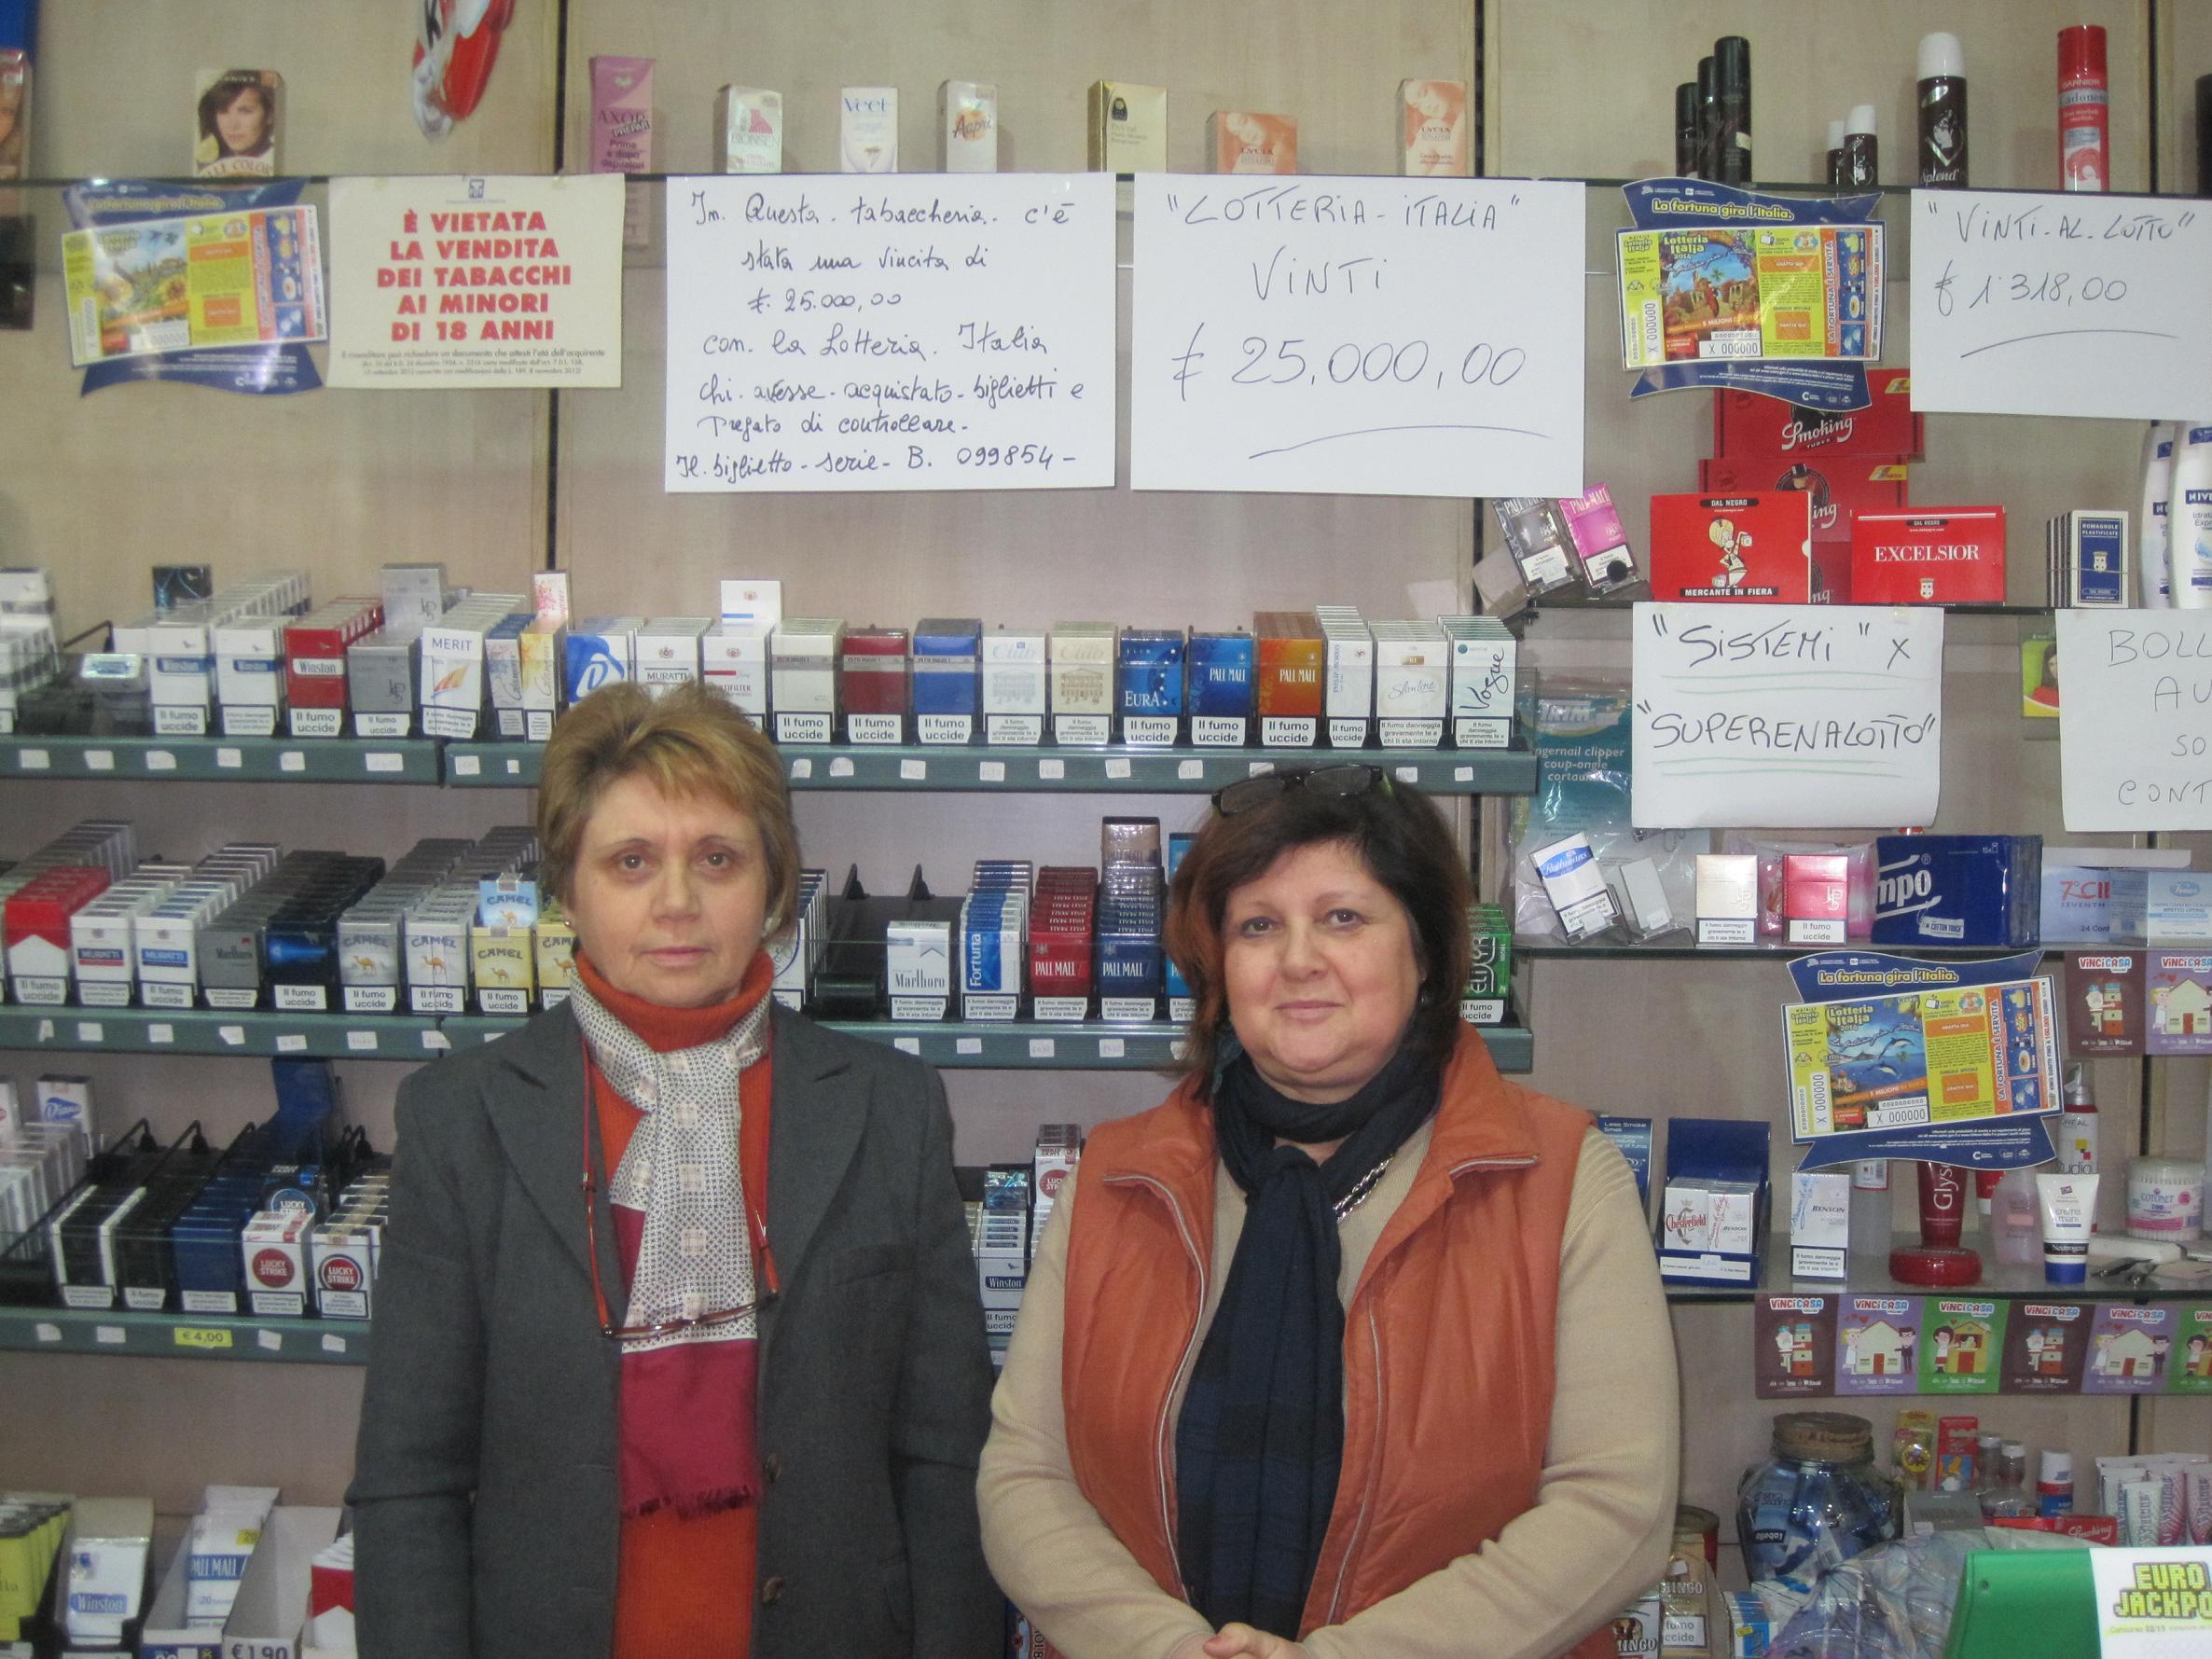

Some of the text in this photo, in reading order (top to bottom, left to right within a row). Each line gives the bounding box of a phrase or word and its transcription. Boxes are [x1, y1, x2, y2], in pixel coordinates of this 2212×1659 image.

[1653, 200, 1667, 213] La
[1671, 202, 1718, 214] fortuna
[1721, 206, 1746, 219] gira
[404, 209, 546, 233] È VIETATA
[1664, 235, 1708, 245] Lotteria
[391, 239, 559, 260] LA VENDITA
[742, 239, 794, 271] stata
[809, 256, 861, 270] una
[966, 244, 989, 268] di
[1670, 244, 1705, 255] Italia
[1826, 242, 1834, 277] SERVITA
[378, 266, 572, 287] DEI TABACCHI
[1252, 245, 1388, 299] VINTI
[398, 294, 548, 313] AI MINORI
[392, 321, 554, 340] DI 18 ANNI
[771, 331, 806, 354] la
[958, 321, 1046, 353] Italia
[1829, 333, 1835, 343] LA
[1721, 343, 1758, 353] 000000
[1070, 384, 1084, 399] e
[801, 411, 823, 434] di
[1781, 417, 1853, 450] Smoking
[1874, 545, 1980, 561] EXCELSIOR
[1685, 588, 1731, 597] MERCANTE
[432, 638, 473, 652] MERIT
[299, 661, 338, 673] Winston
[647, 671, 687, 682] MURATTI
[1210, 669, 1246, 682] PALL MALL
[1279, 669, 1316, 683] PALL MALL
[1459, 648, 1509, 710] Vogue
[1125, 691, 1160, 707] EURA
[306, 712, 335, 722] fumo
[864, 718, 894, 728] fumo
[297, 724, 335, 733] uccide
[1209, 720, 1239, 731] fumo
[855, 730, 894, 740] uccide
[1198, 731, 1238, 742] uccide
[1536, 746, 1624, 758] ngernail clipper
[1544, 760, 1609, 771] coup-ongle
[1543, 851, 1588, 877] Rothmans
[1877, 869, 1931, 907] mpo
[487, 894, 532, 906] CAMEL
[343, 935, 388, 948] CAMEL
[411, 936, 457, 948] CAMEL
[542, 937, 575, 948] CAM
[477, 948, 523, 959] CAMEL
[970, 934, 981, 987] Fortuna
[2080, 958, 2131, 969] VINCICASA
[1036, 962, 1075, 976] PALL MALL
[1103, 962, 1144, 976] PALL MALL
[895, 970, 945, 988] Marlboro
[1819, 972, 1834, 983] La
[1837, 969, 1883, 983] fortuna
[1886, 971, 1911, 985] gira
[30, 980, 60, 990] fumo
[22, 991, 60, 1002] uccide
[362, 990, 385, 999] fumo
[1831, 1005, 1873, 1016] Lotteria
[1836, 1015, 1870, 1025] Italia
[1991, 1000, 2000, 1035] SERVITA
[1995, 1045, 2004, 1085] FORTUNA
[1998, 1087, 2005, 1099] LA
[1889, 1109, 1926, 1122] 000000
[2141, 1194, 2174, 1202] COTONET
[1666, 1213, 1707, 1232] Chesterfield
[260, 1267, 287, 1276] STRIKE
[328, 1275, 355, 1284] STRIKE
[988, 1277, 1022, 1288] Winston
[1770, 1298, 1824, 1309] VINCICASA
[1854, 1300, 1909, 1310] VINCICASA
[1940, 1302, 1993, 1313] VINCICASA
[2025, 1306, 2079, 1317] VINCICASA
[2110, 1309, 2164, 1320] VINCICASA
[2068, 1525, 2111, 1540] Smoking
[212, 1557, 237, 1577] MALL
[2134, 1563, 2205, 1590] EURO
[76, 1594, 123, 1611] Winston
[2114, 1591, 2212, 1619] JACKPO
[1666, 1620, 1694, 1629] fumo
[1664, 1633, 1694, 1642] ccide
